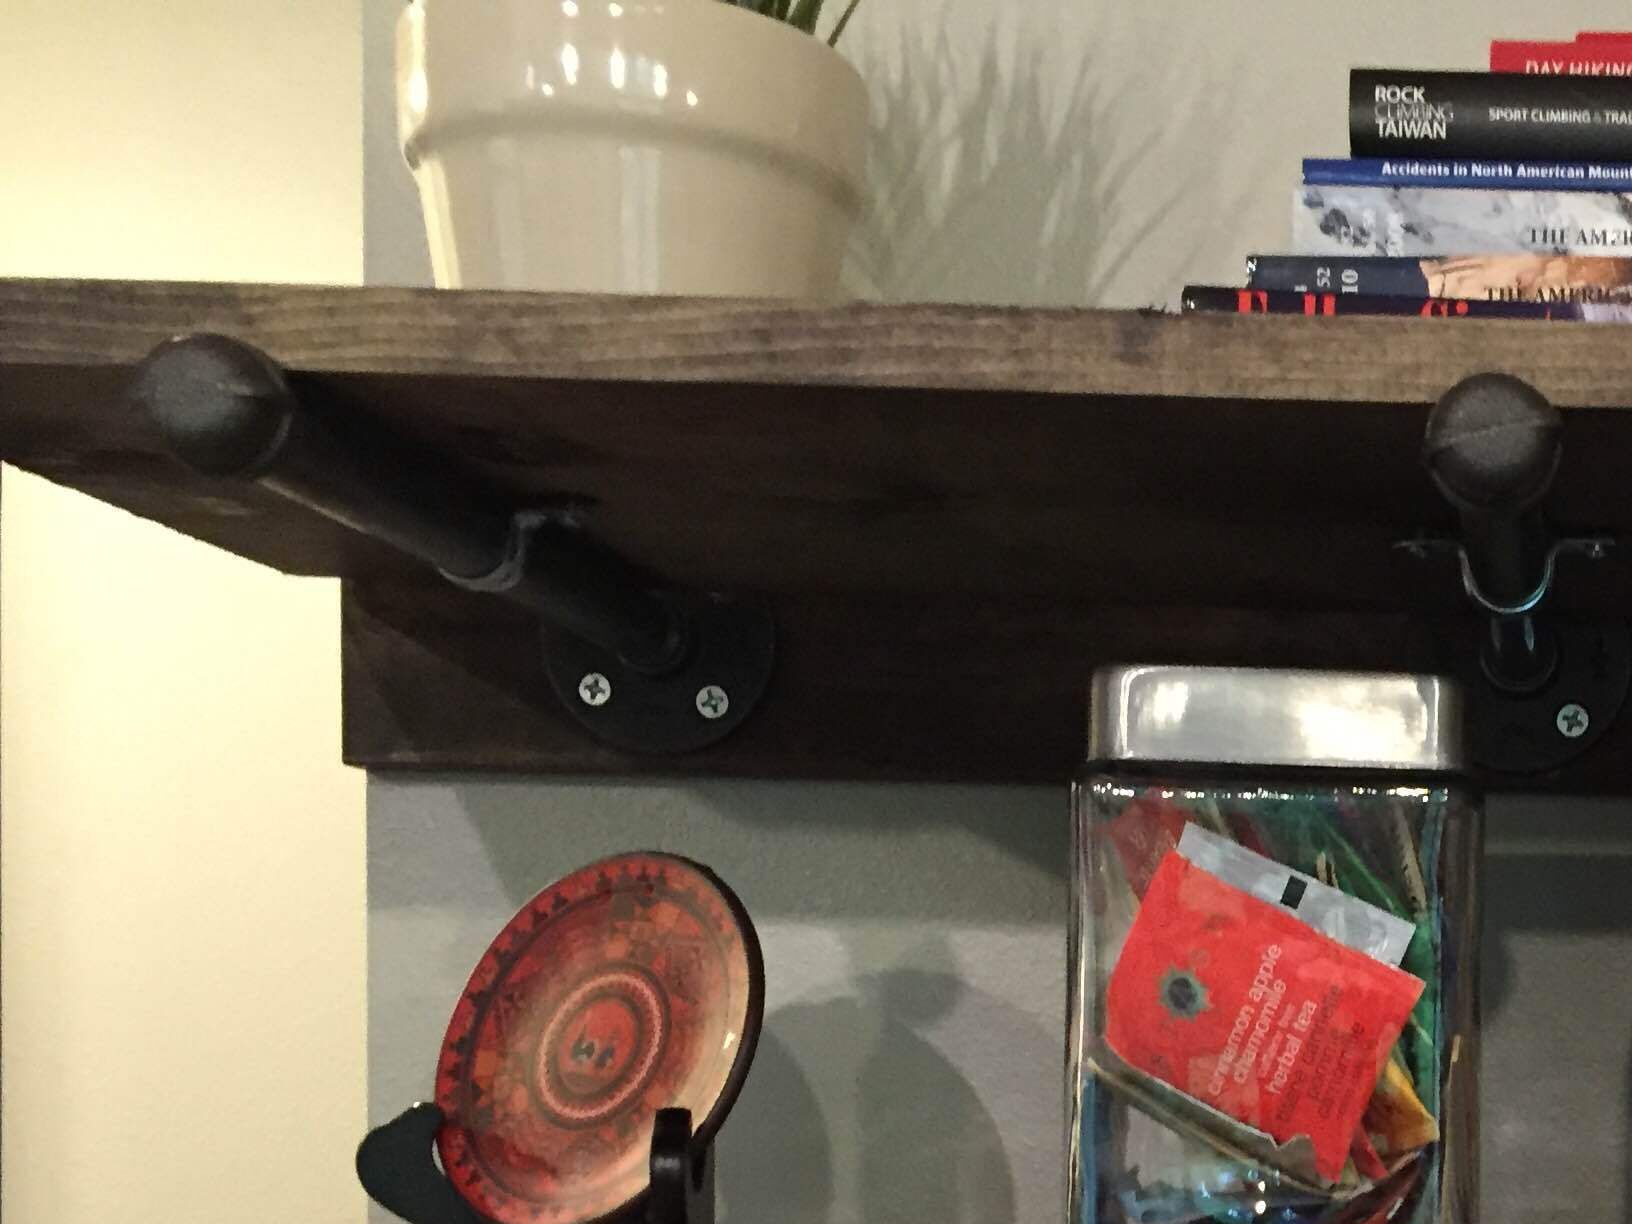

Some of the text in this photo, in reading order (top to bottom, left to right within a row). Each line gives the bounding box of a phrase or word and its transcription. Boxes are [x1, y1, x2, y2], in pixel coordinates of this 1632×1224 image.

[1525, 60, 1565, 76] DAY
[1374, 84, 1426, 104] ROCK
[1374, 102, 1454, 123] CLIMBING
[1488, 107, 1528, 122] SPORT
[1530, 108, 1591, 124] CLIMBING
[1375, 119, 1447, 140] TAIWAN
[1381, 161, 1450, 177] Accidents
[1453, 163, 1467, 177] in
[1471, 163, 1513, 178] North
[1516, 163, 1585, 180] American
[1316, 266, 1331, 288] 52
[1341, 268, 1359, 295] 10
[1208, 944, 1282, 1096] cinnamon apple
[1233, 979, 1287, 1084] chamomile
[1265, 999, 1318, 1094] herbal tea
